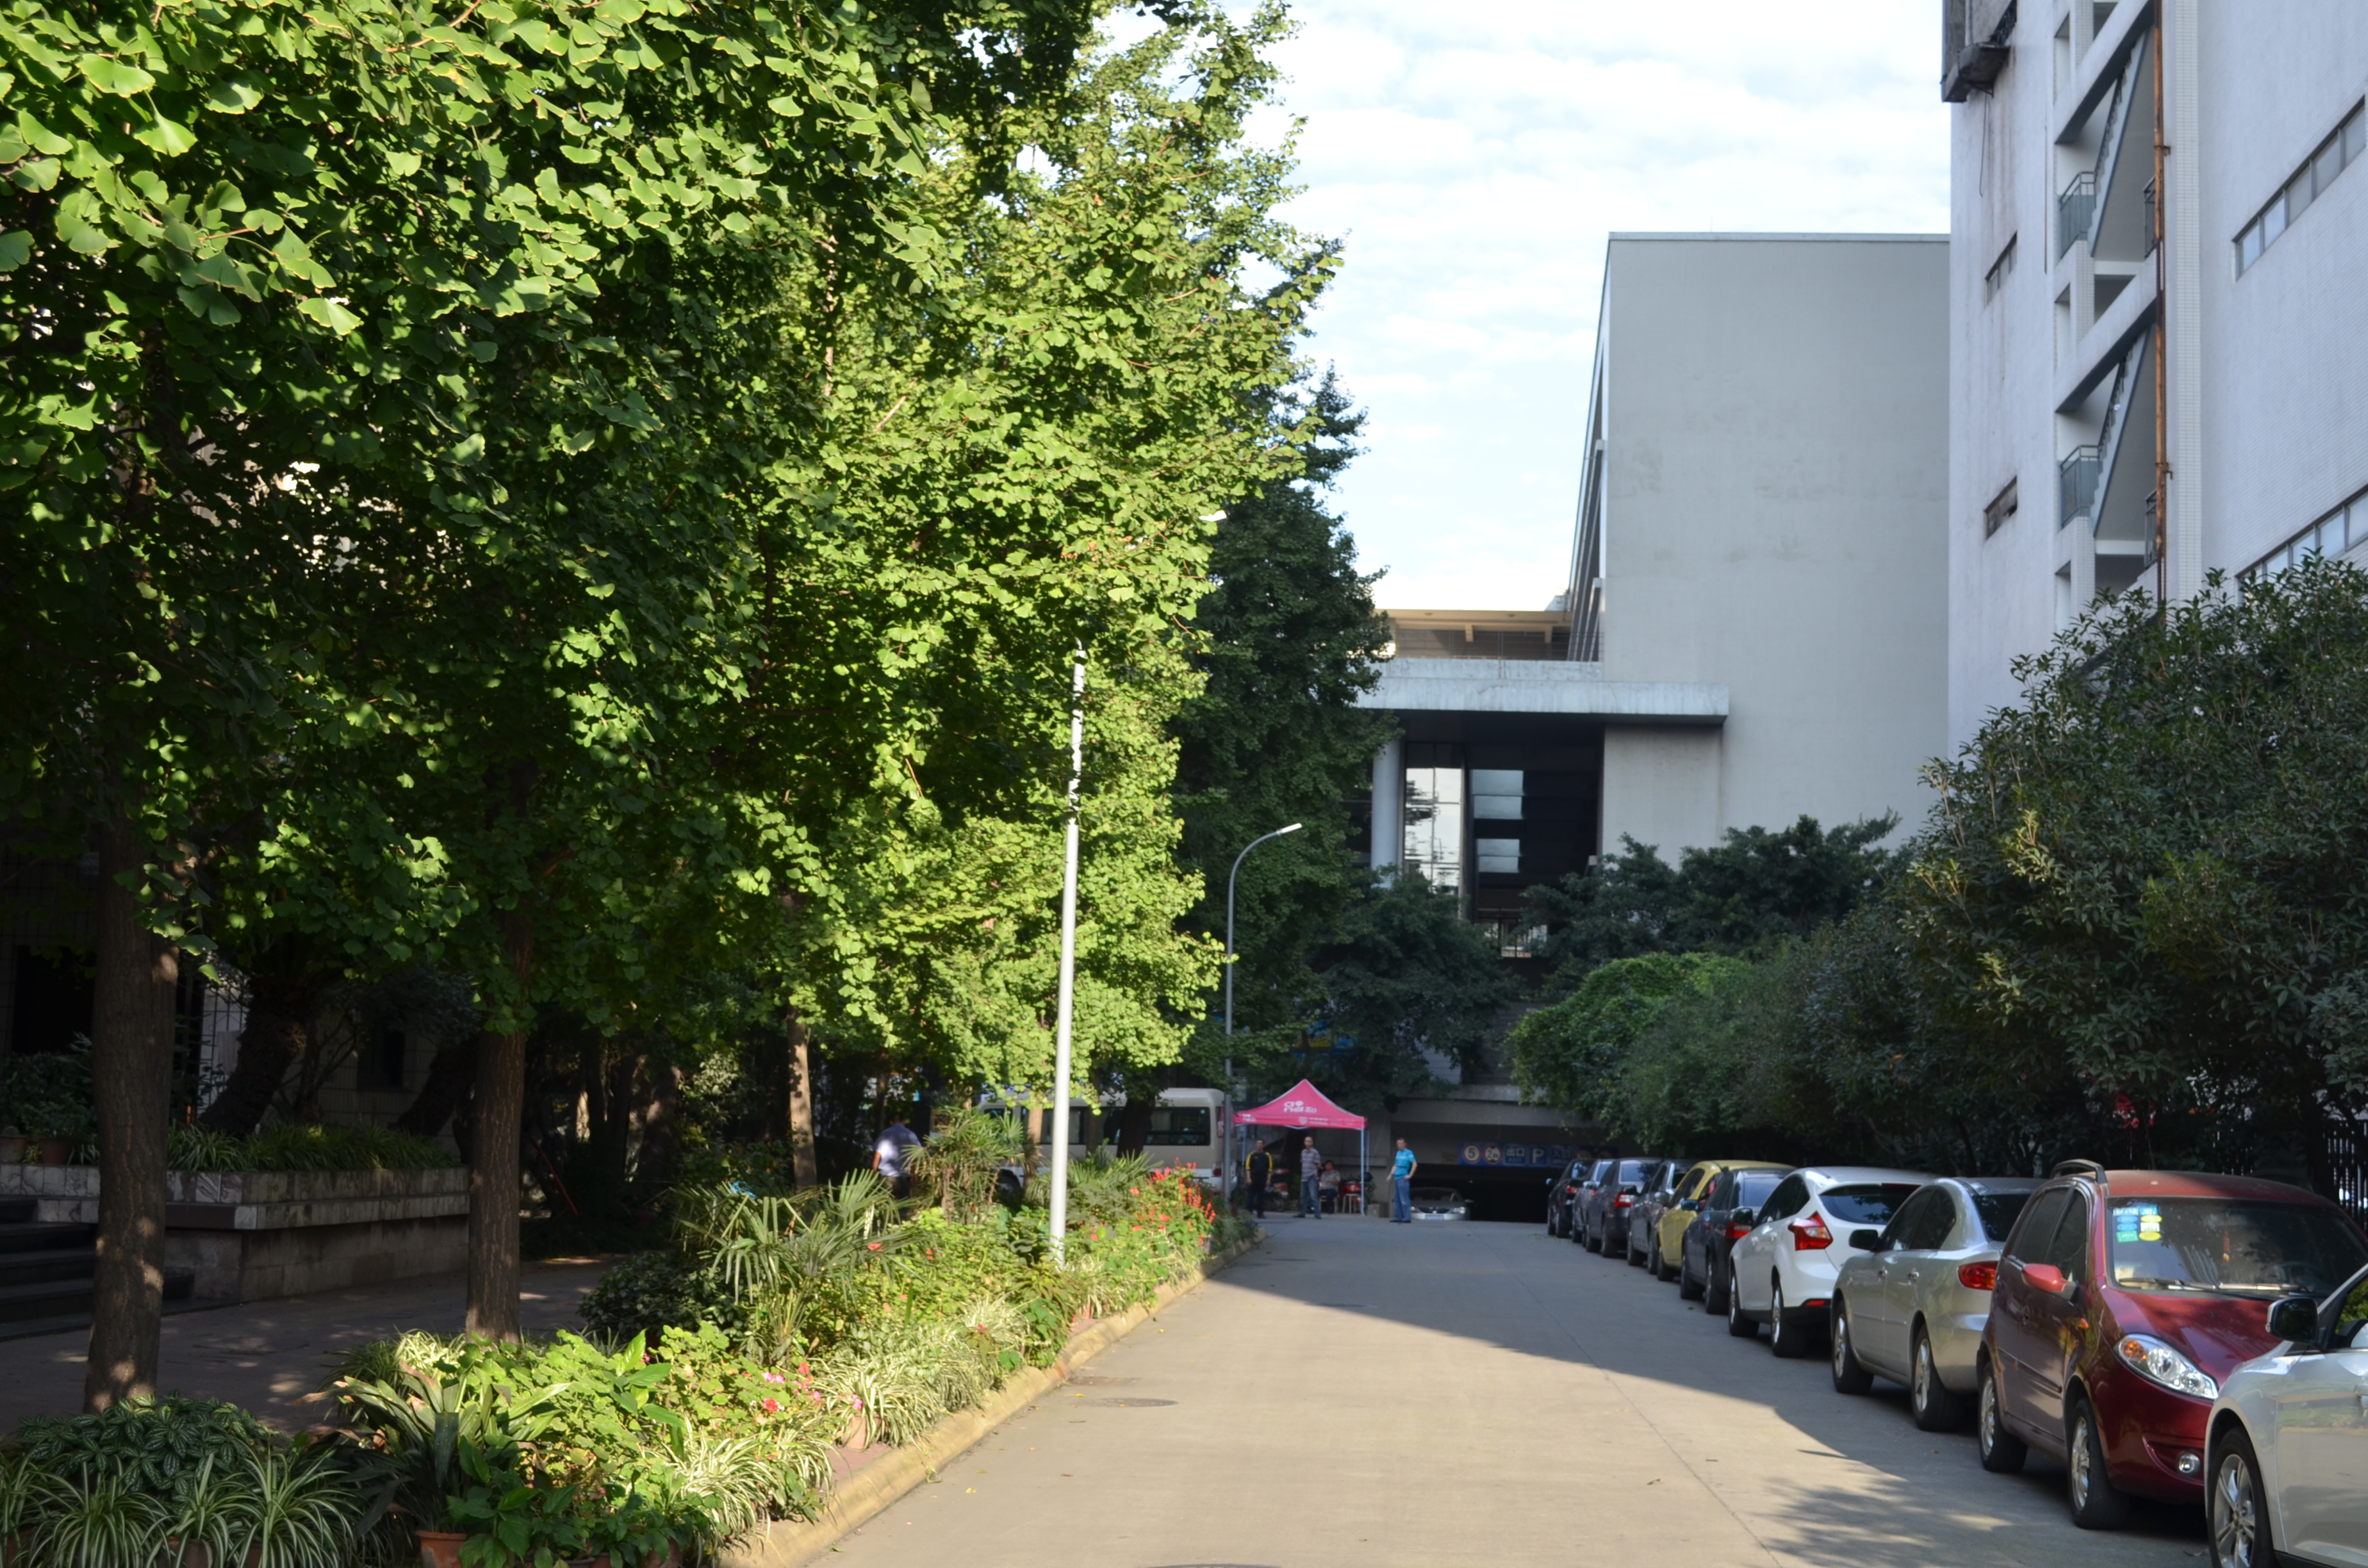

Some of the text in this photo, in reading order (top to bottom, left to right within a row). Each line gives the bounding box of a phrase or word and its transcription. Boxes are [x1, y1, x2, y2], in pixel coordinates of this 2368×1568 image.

[1468, 1148, 1475, 1158] 5
[1506, 1147, 1525, 1157] 出口
[1533, 1148, 1544, 1163] P
